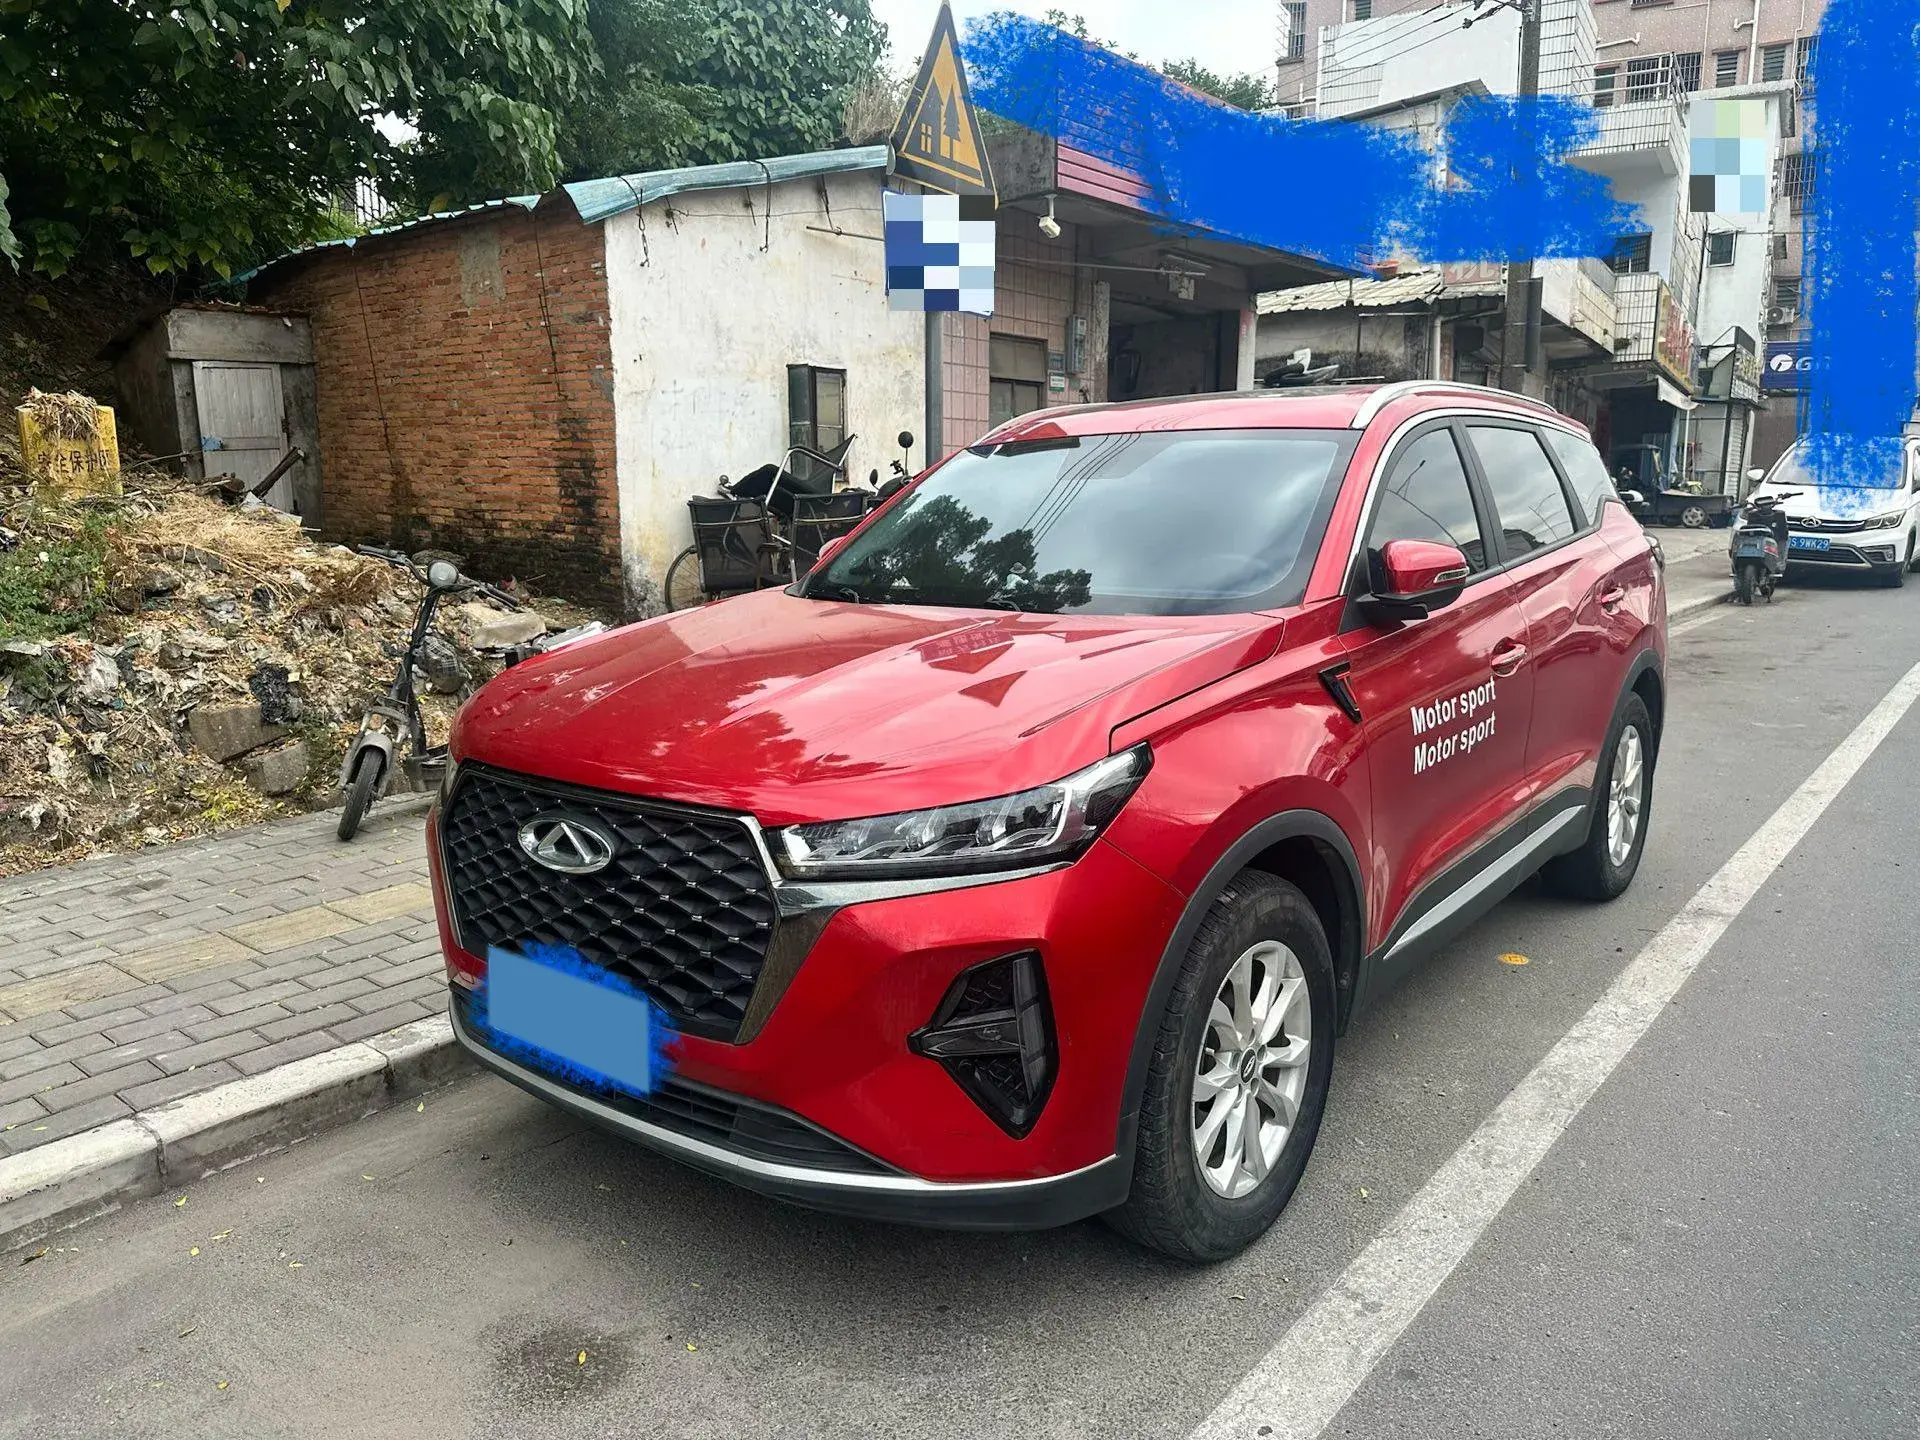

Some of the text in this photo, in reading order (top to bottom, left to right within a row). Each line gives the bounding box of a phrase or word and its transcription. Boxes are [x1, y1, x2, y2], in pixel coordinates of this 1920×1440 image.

[1410, 675, 1496, 735] Motor sport
[1414, 710, 1496, 774] Motor sport
